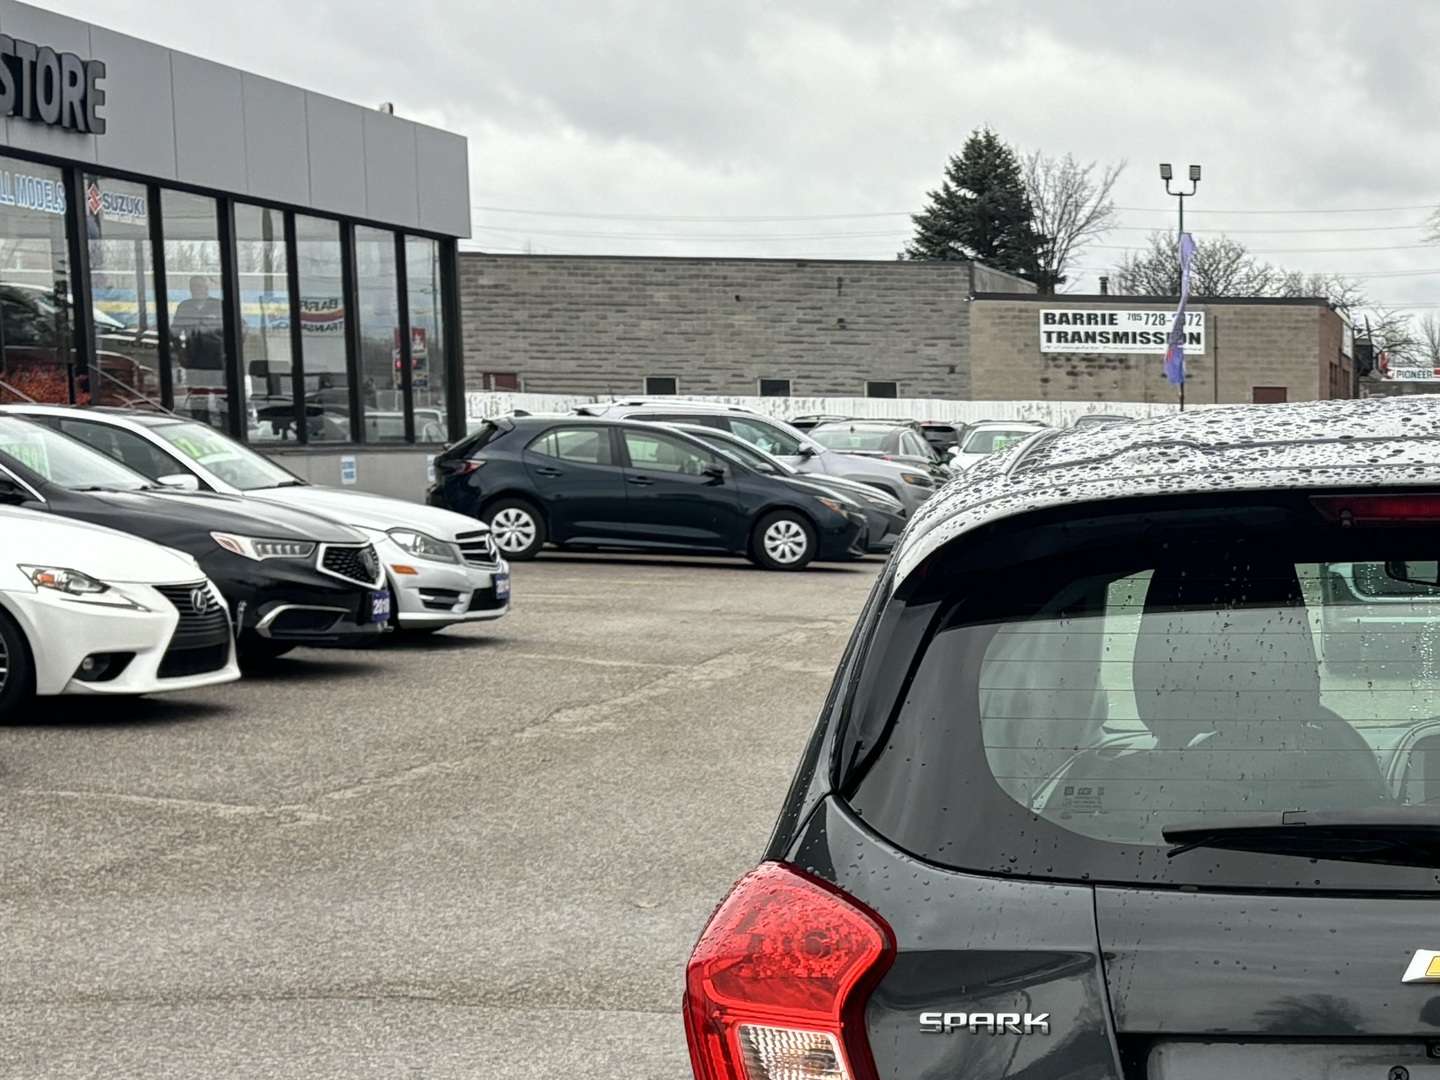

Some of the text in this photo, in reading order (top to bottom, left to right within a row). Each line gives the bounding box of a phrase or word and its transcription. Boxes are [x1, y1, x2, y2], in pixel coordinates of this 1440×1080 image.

[15, 173, 66, 215] MODELS
[102, 191, 146, 217] SUZUKI
[1043, 312, 1118, 326] BARRIE
[1144, 313, 1202, 327] 728-72
[1043, 331, 1202, 345] TRANSMISSN
[919, 1012, 1050, 1035] SPARK
